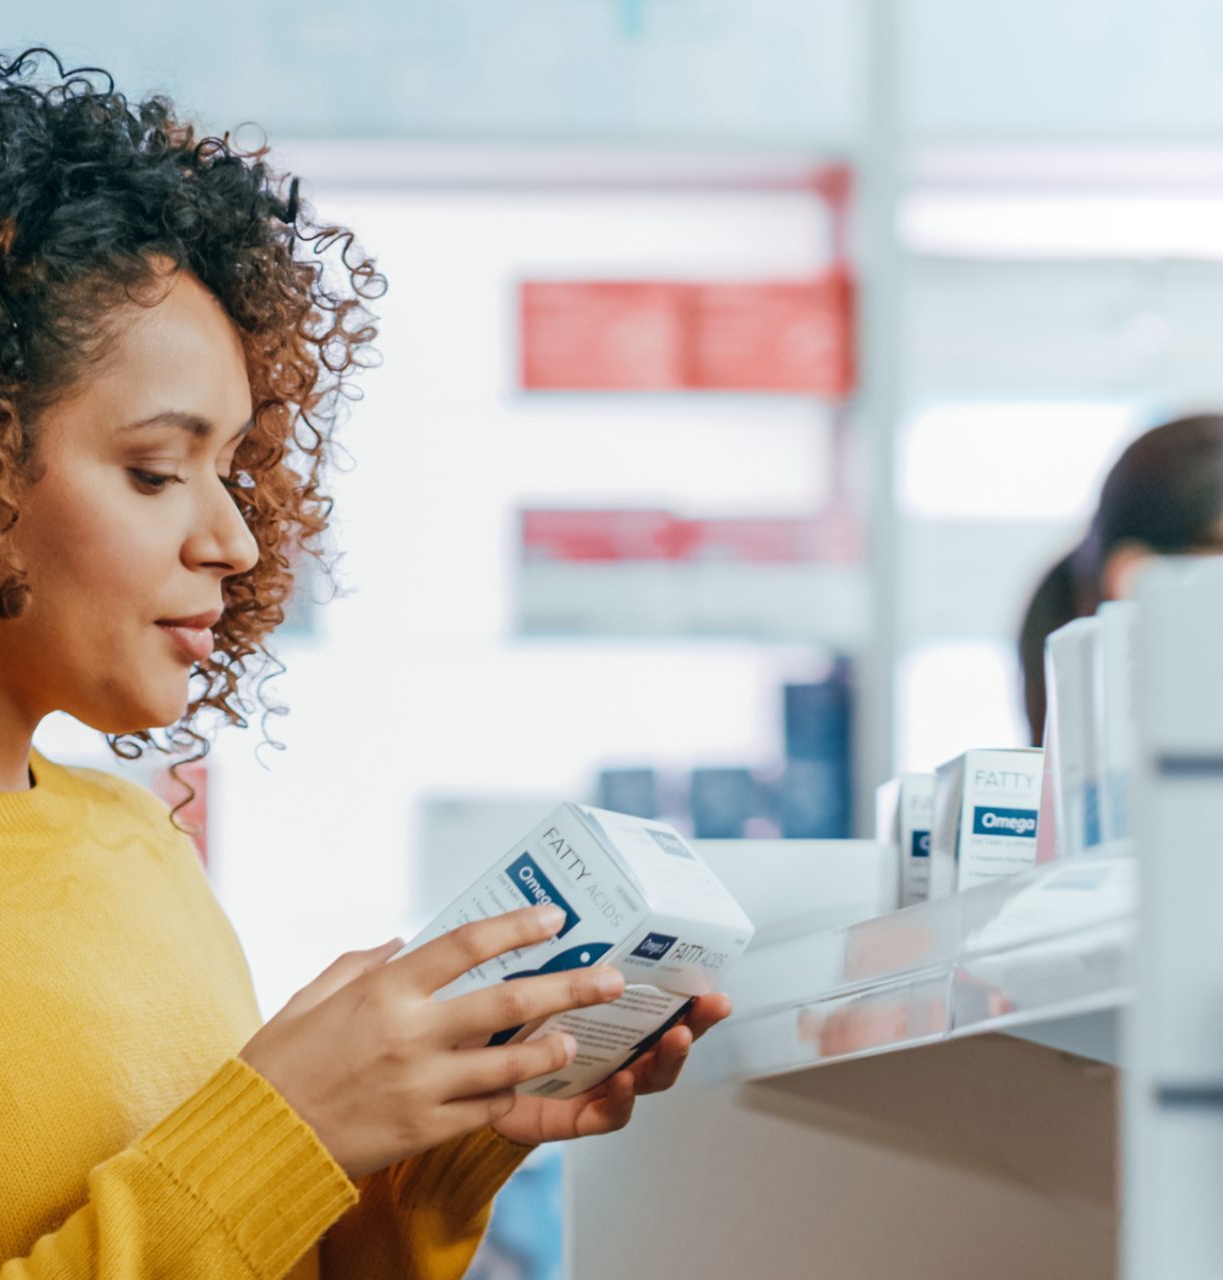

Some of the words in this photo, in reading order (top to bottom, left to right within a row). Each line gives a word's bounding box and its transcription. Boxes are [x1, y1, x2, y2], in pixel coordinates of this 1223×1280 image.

[974, 769, 1035, 790] FATTY
[981, 812, 1036, 834] Omega
[518, 865, 555, 906] Omeg
[542, 826, 592, 881] FATTY
[585, 884, 624, 928] ACIDS
[668, 942, 708, 964] FATTY
